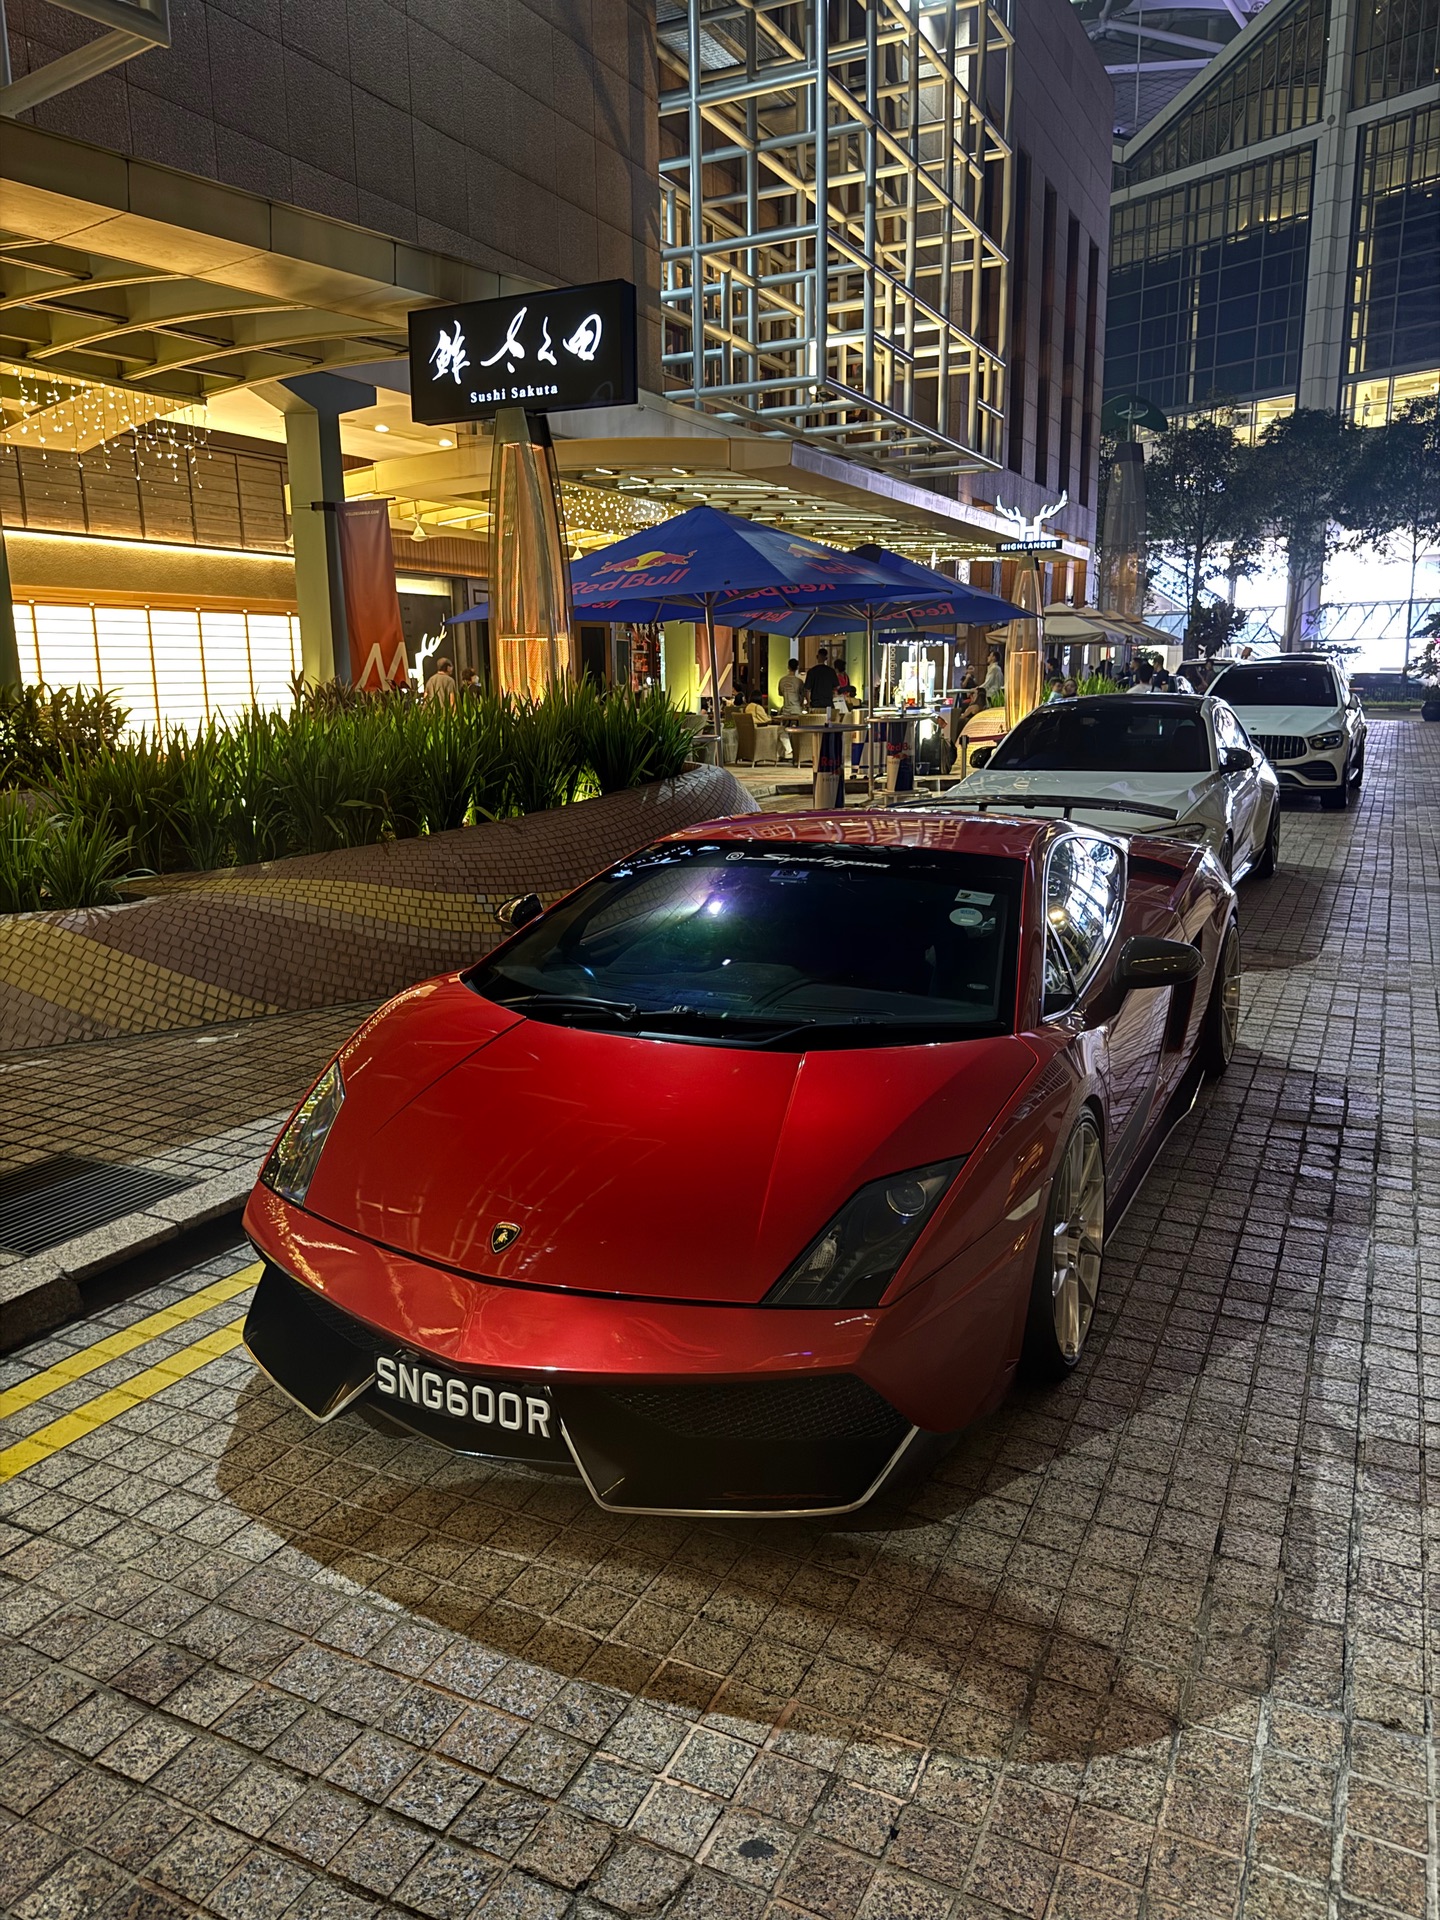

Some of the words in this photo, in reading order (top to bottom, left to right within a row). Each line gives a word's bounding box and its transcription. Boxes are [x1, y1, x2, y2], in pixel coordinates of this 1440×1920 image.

[470, 386, 506, 404] Sushi
[511, 384, 558, 399] Sakuta
[1001, 541, 1057, 551] HIGHLANDER
[571, 574, 627, 595] Red
[620, 568, 691, 589] Bull
[376, 1356, 550, 1438] SNG600R
